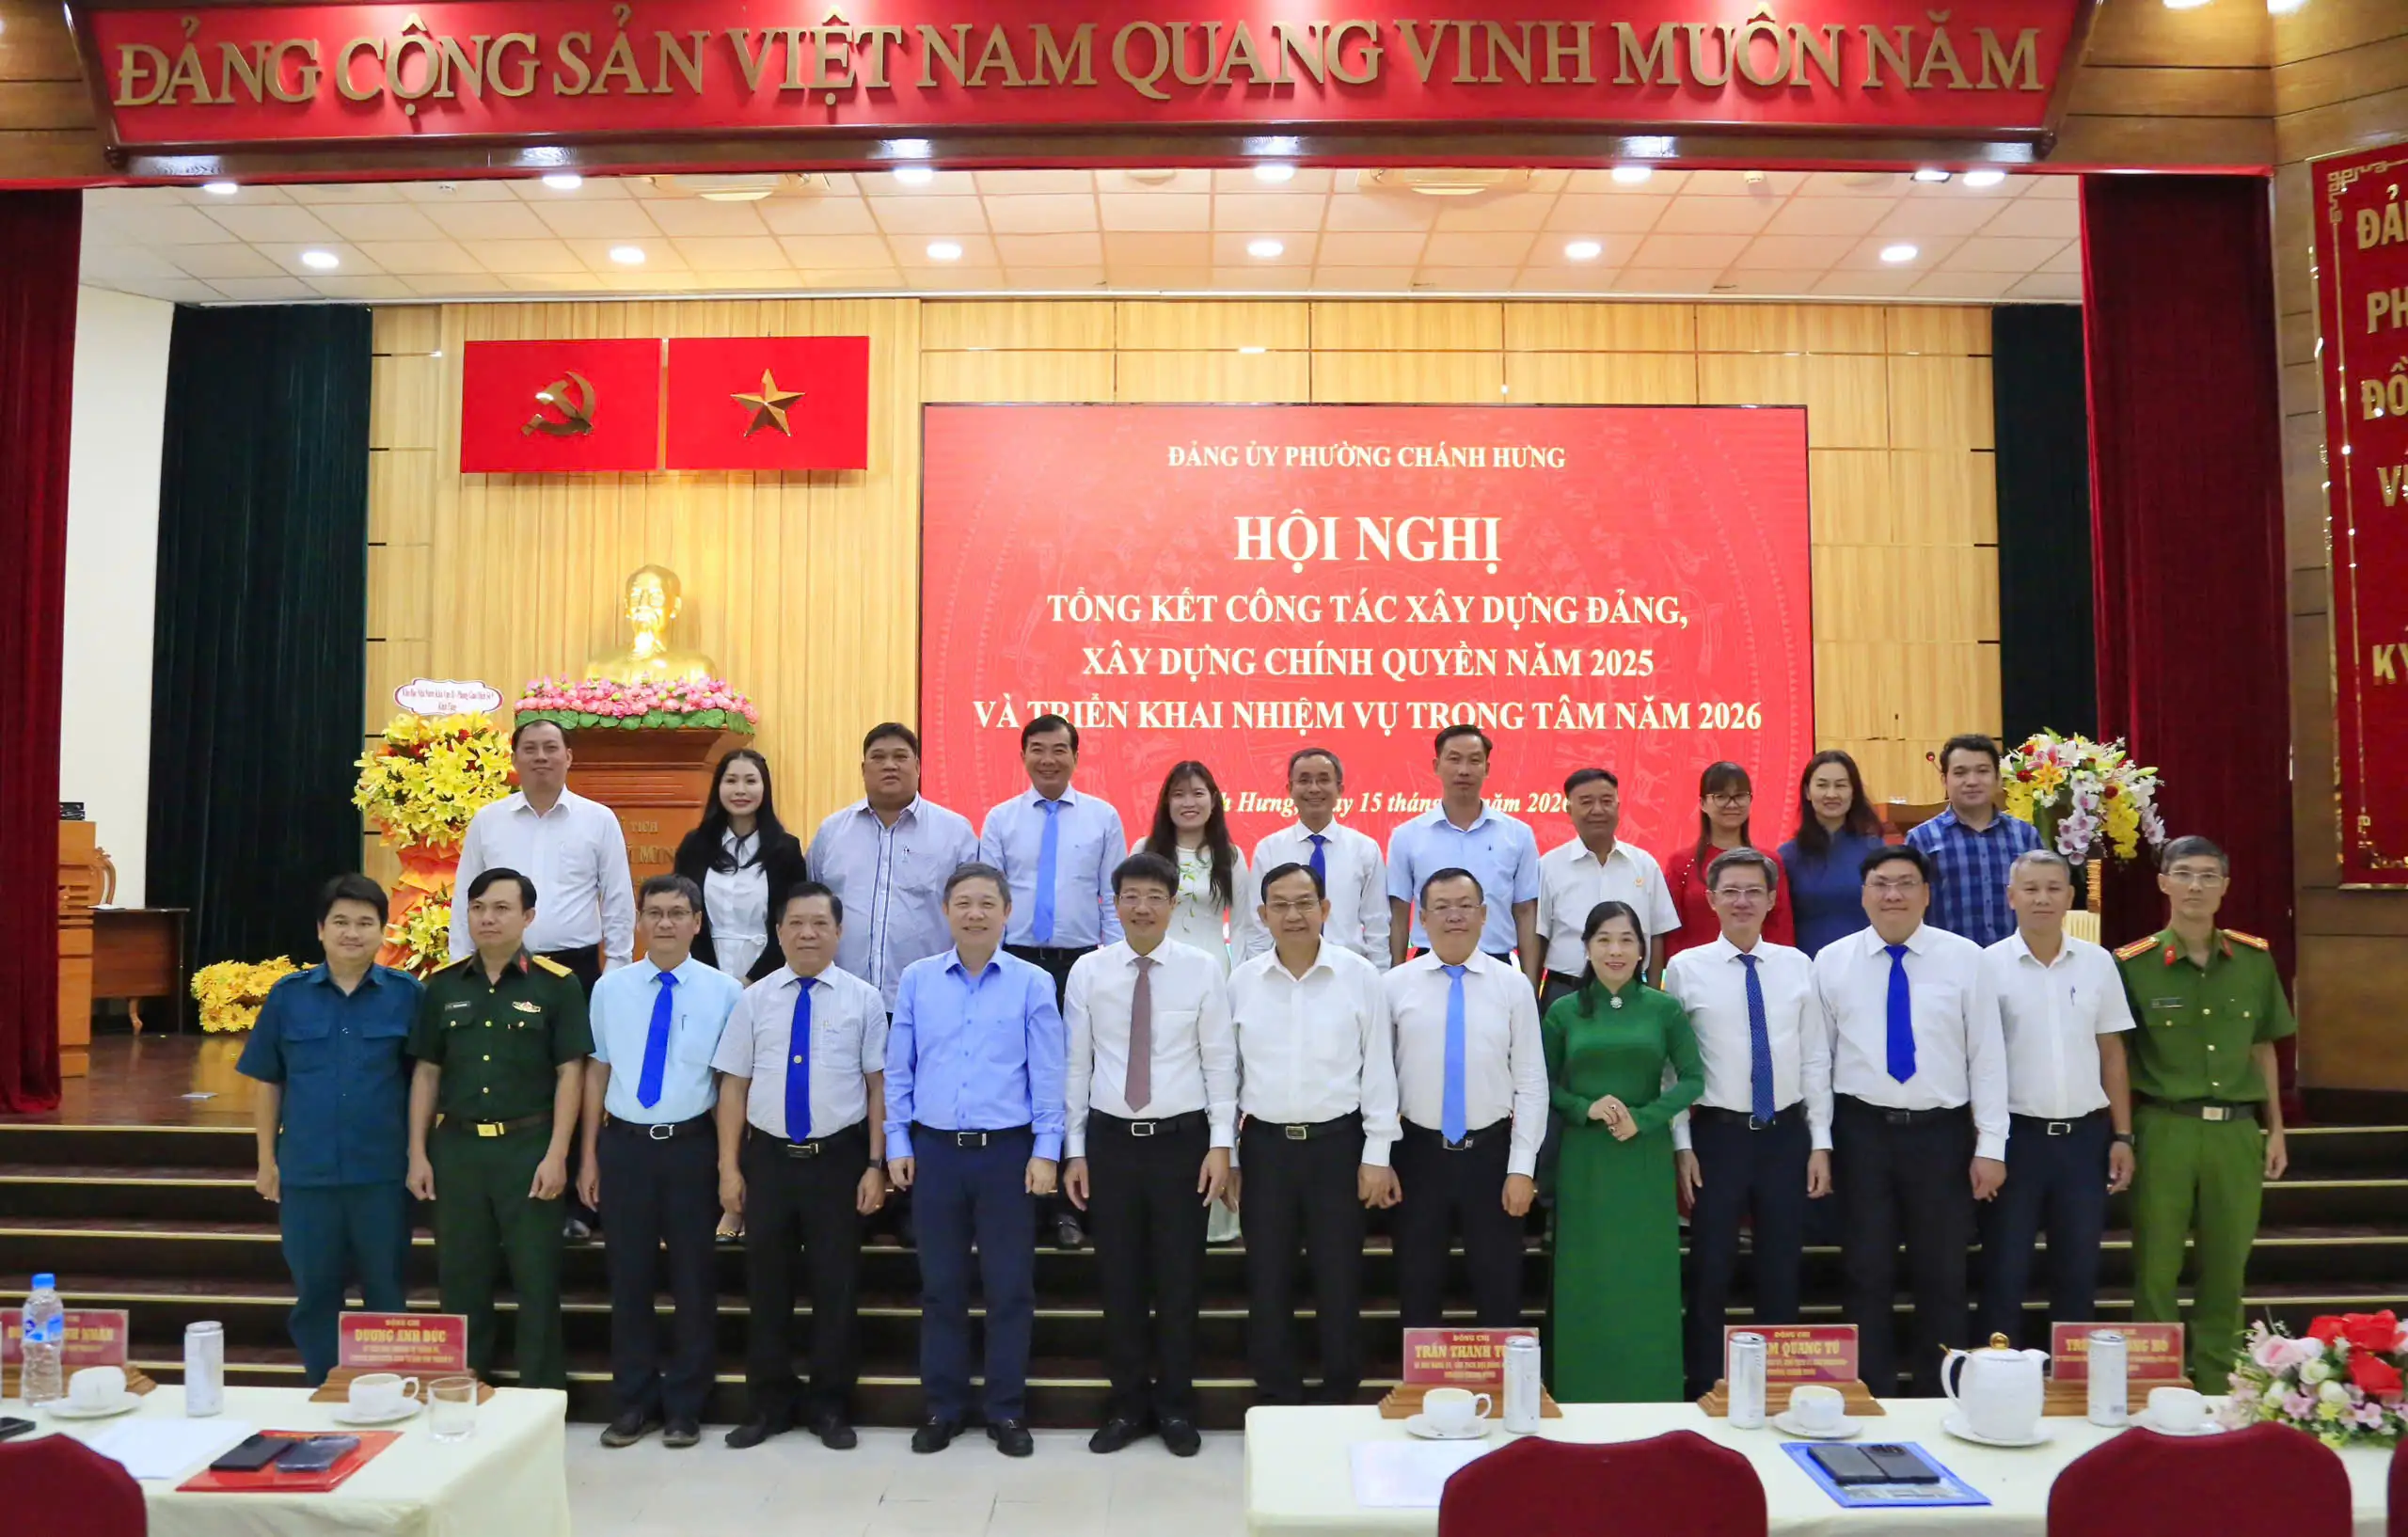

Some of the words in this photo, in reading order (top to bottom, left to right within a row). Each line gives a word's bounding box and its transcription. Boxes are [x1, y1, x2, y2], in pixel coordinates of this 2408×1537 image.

[113, 16, 322, 106] ĐẢNG
[336, 12, 541, 116] CỘNG
[553, 4, 710, 95] SẢN
[726, 4, 903, 105] VIỆT
[916, 23, 1099, 88] NAM
[1112, 19, 1384, 100] QUANG
[1393, 19, 1597, 87] VINH
[1611, 1, 1845, 87] MUÔN
[1860, 9, 2045, 90] NĂM
[2356, 183, 2408, 249] ĐẢ
[1167, 440, 1239, 467] ĐẢNG
[1245, 440, 1280, 467] ỦY
[1284, 440, 1392, 468] PHƯỜNG
[1397, 440, 1486, 468] CHÁNH
[1492, 444, 1566, 468] HƯNG
[1233, 507, 1340, 574] HỘI
[1354, 515, 1502, 575] NGHỊ
[1046, 586, 1142, 623] TỔNG
[1149, 586, 1218, 623] KẾT
[1226, 586, 1323, 623] CÔNG
[1329, 587, 1398, 623] TÁC
[1404, 587, 1476, 624] XÂY
[1481, 592, 1579, 631] DỰNG
[1586, 588, 1688, 629] ĐẢNG,
[1082, 639, 1152, 675] XÂY
[1158, 643, 1257, 683] DỰNG
[1263, 640, 1374, 676] CHÍNH
[1381, 640, 1497, 682] QUYỀN
[1505, 642, 1582, 676] NĂM
[1590, 649, 1654, 677] 2025
[973, 692, 1021, 728] VÀ
[1137, 701, 1224, 729] KHAI
[1231, 697, 1345, 737] NHIỆM
[1352, 701, 1399, 737] VỤ
[1531, 694, 1607, 730] TÂM
[1614, 694, 1691, 730] NĂM
[1698, 702, 1762, 730] 2026
[1359, 792, 1383, 813] 15
